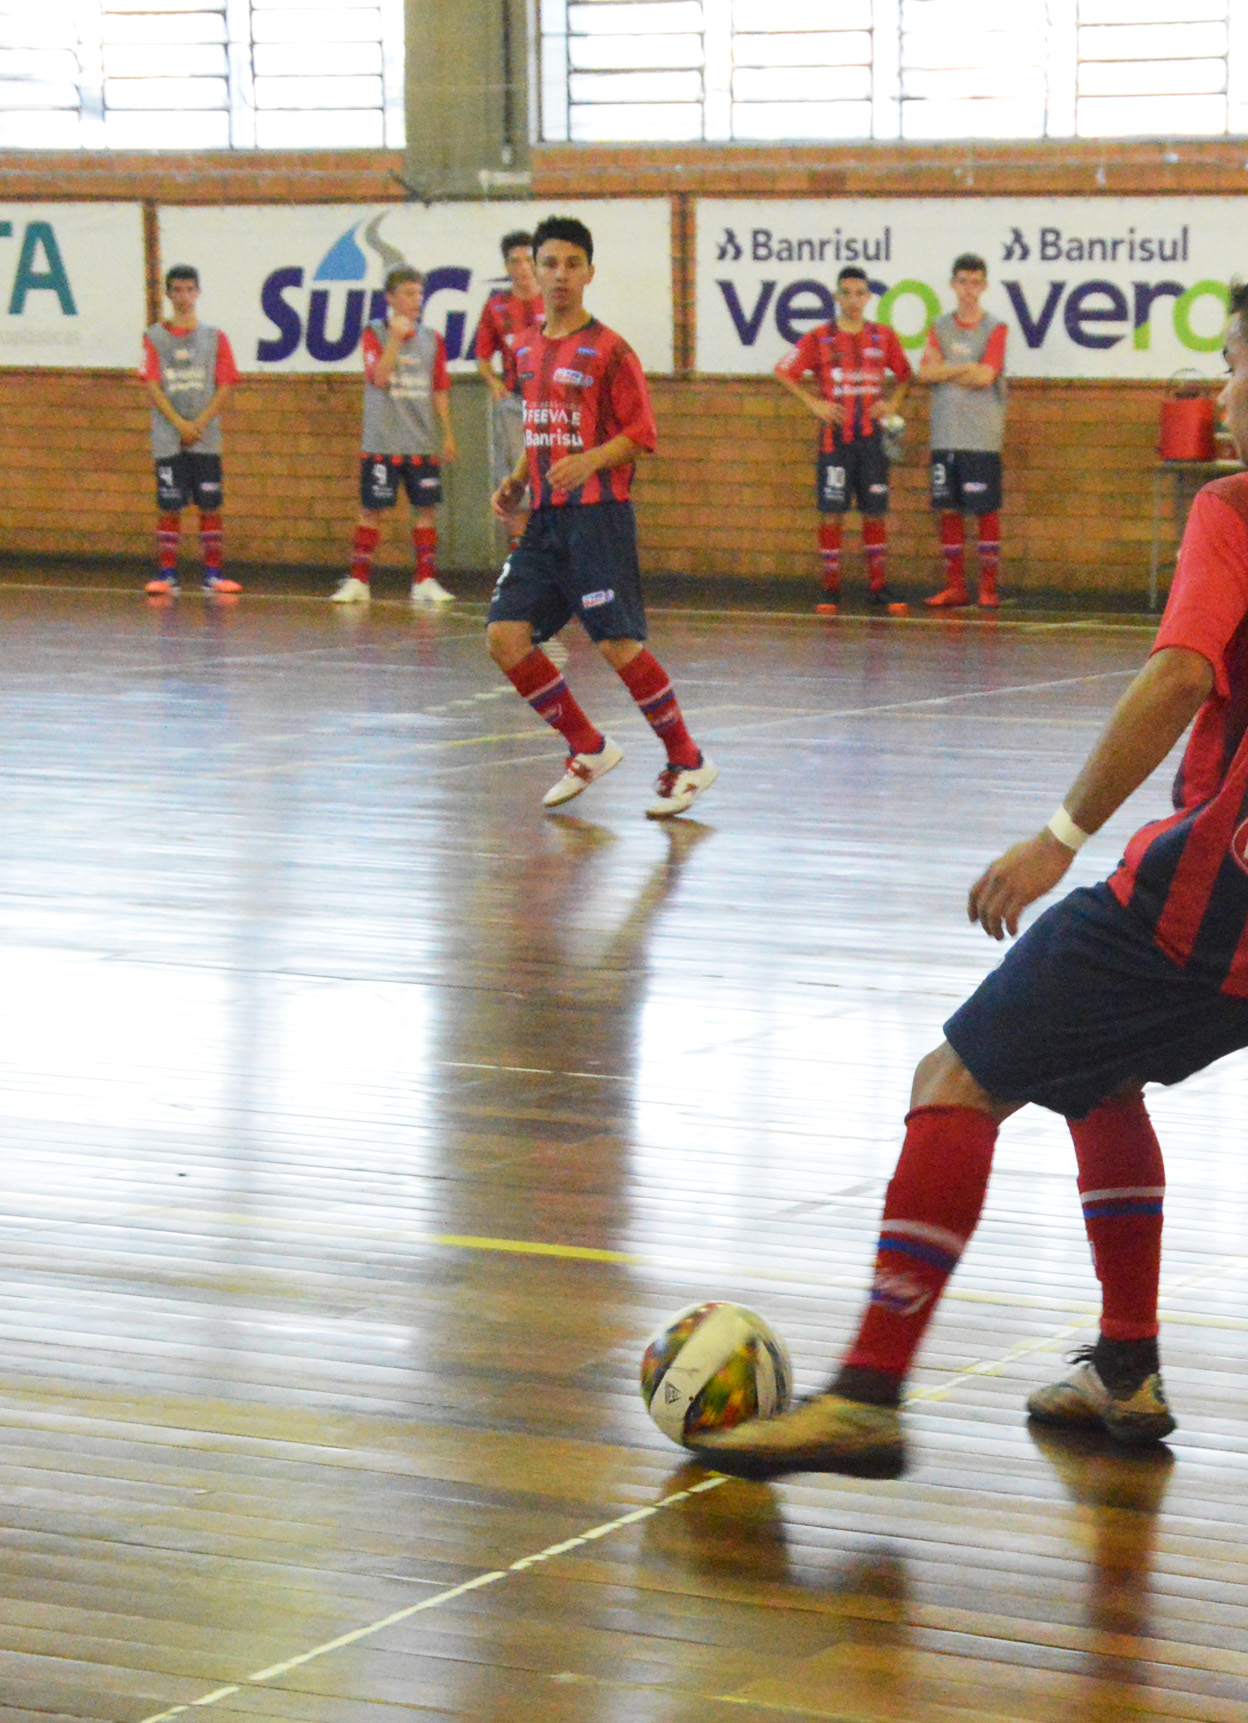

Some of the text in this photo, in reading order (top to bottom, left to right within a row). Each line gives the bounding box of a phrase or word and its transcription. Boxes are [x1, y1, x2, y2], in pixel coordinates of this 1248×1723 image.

[752, 226, 892, 262] Banrisul
[1040, 224, 1189, 262] Banrisul
[715, 278, 942, 350] veo
[1000, 278, 1234, 351] vero
[527, 408, 581, 426] FEEVAE
[525, 428, 584, 447] Banrisu
